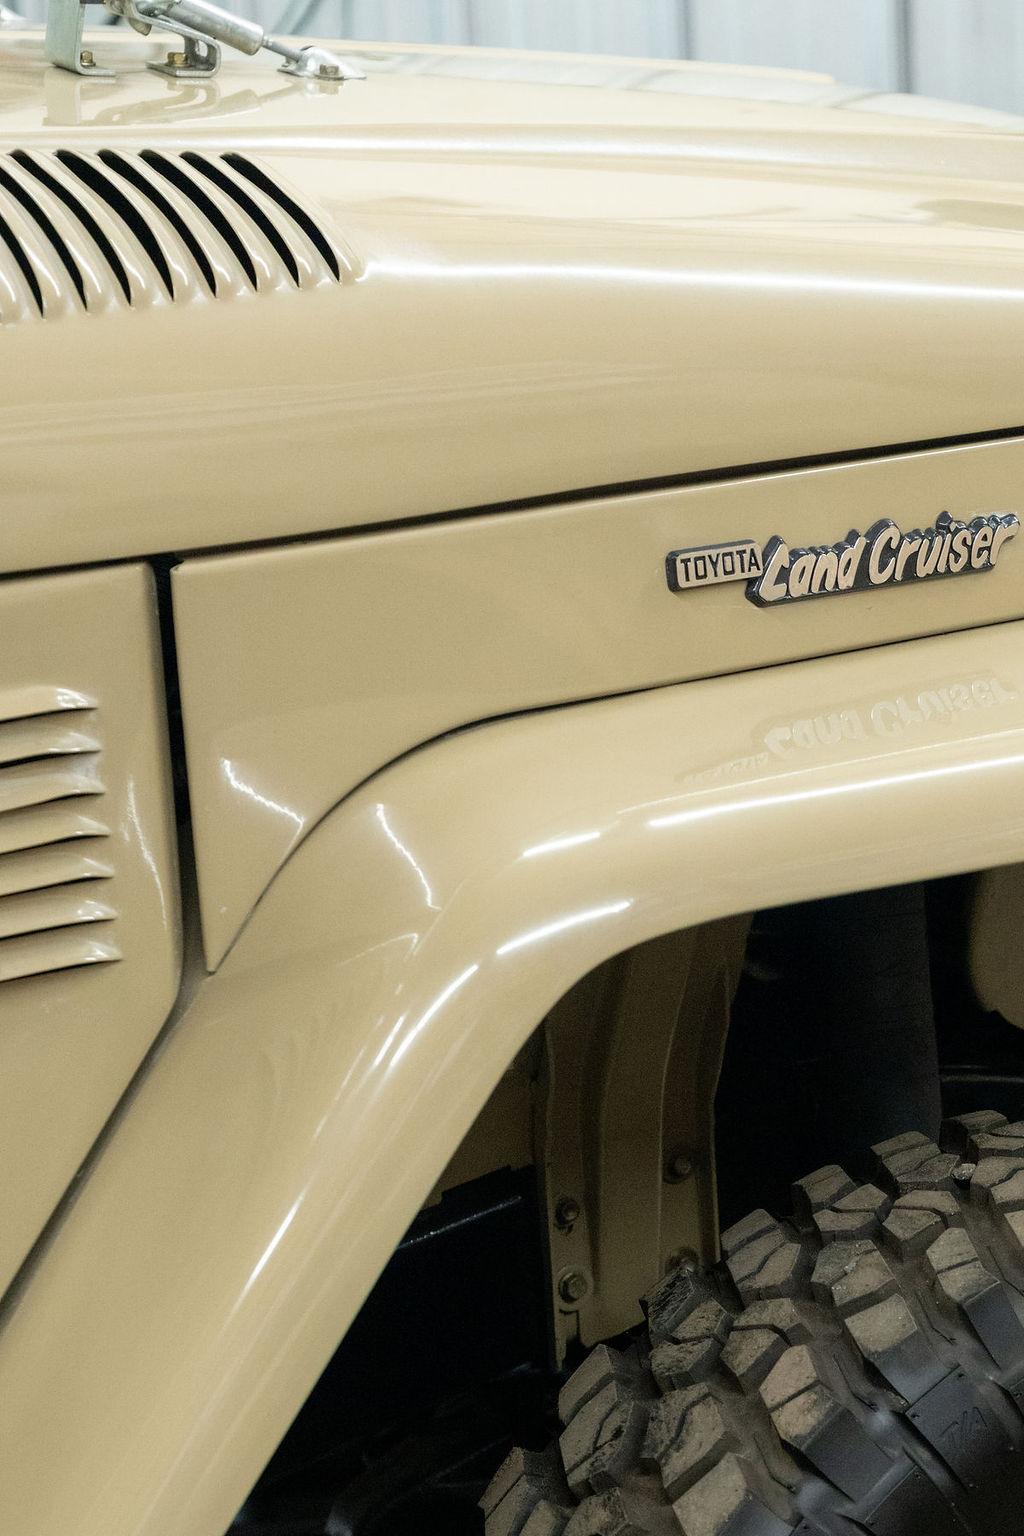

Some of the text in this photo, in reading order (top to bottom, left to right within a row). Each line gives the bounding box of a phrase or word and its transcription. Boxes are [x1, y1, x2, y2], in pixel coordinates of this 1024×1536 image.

[679, 512, 1020, 602] TOYOTA Land Cruiser
